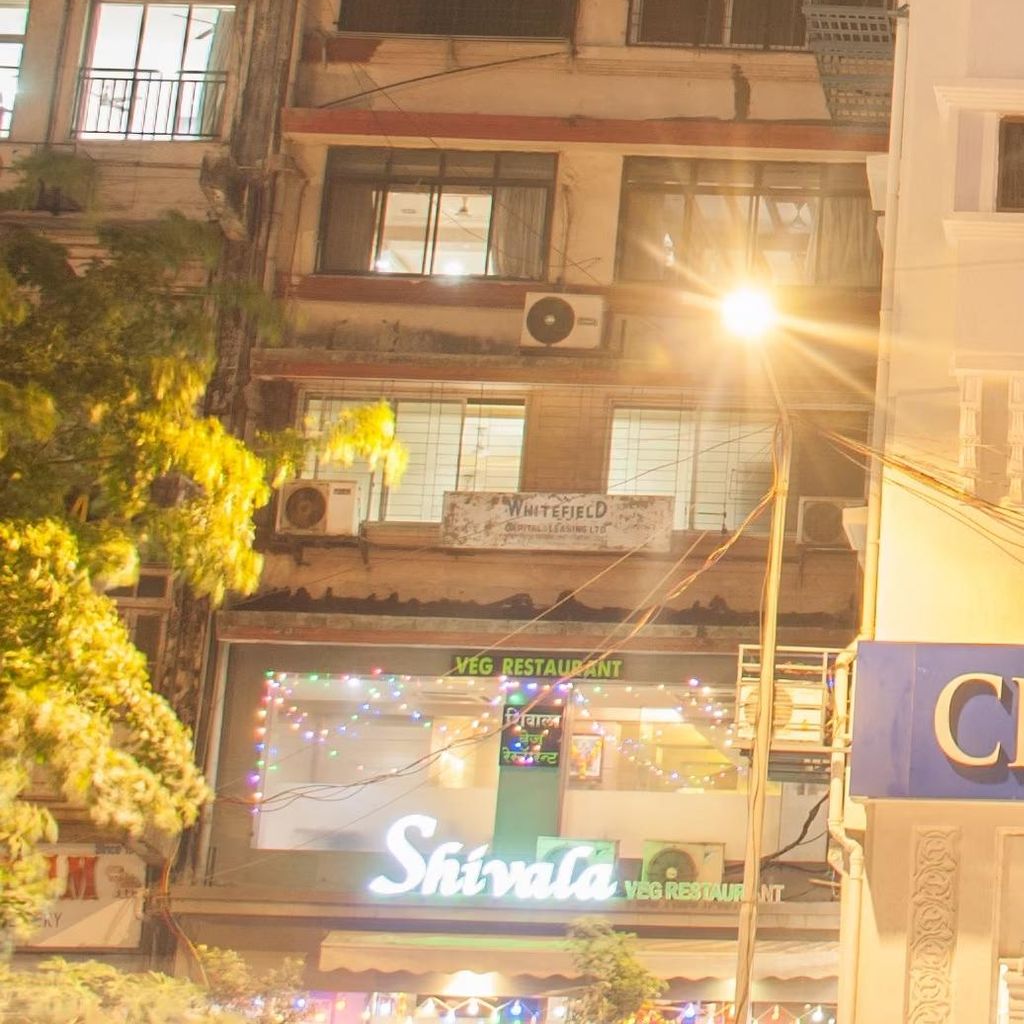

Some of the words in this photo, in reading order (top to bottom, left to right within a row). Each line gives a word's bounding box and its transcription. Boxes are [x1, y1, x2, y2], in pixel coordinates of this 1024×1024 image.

[456, 657, 493, 675] VEG
[502, 659, 623, 677] RESTAURANT
[369, 814, 617, 901] Shivala
[624, 880, 663, 901] VEG
[665, 881, 785, 903] RESTAURNT
